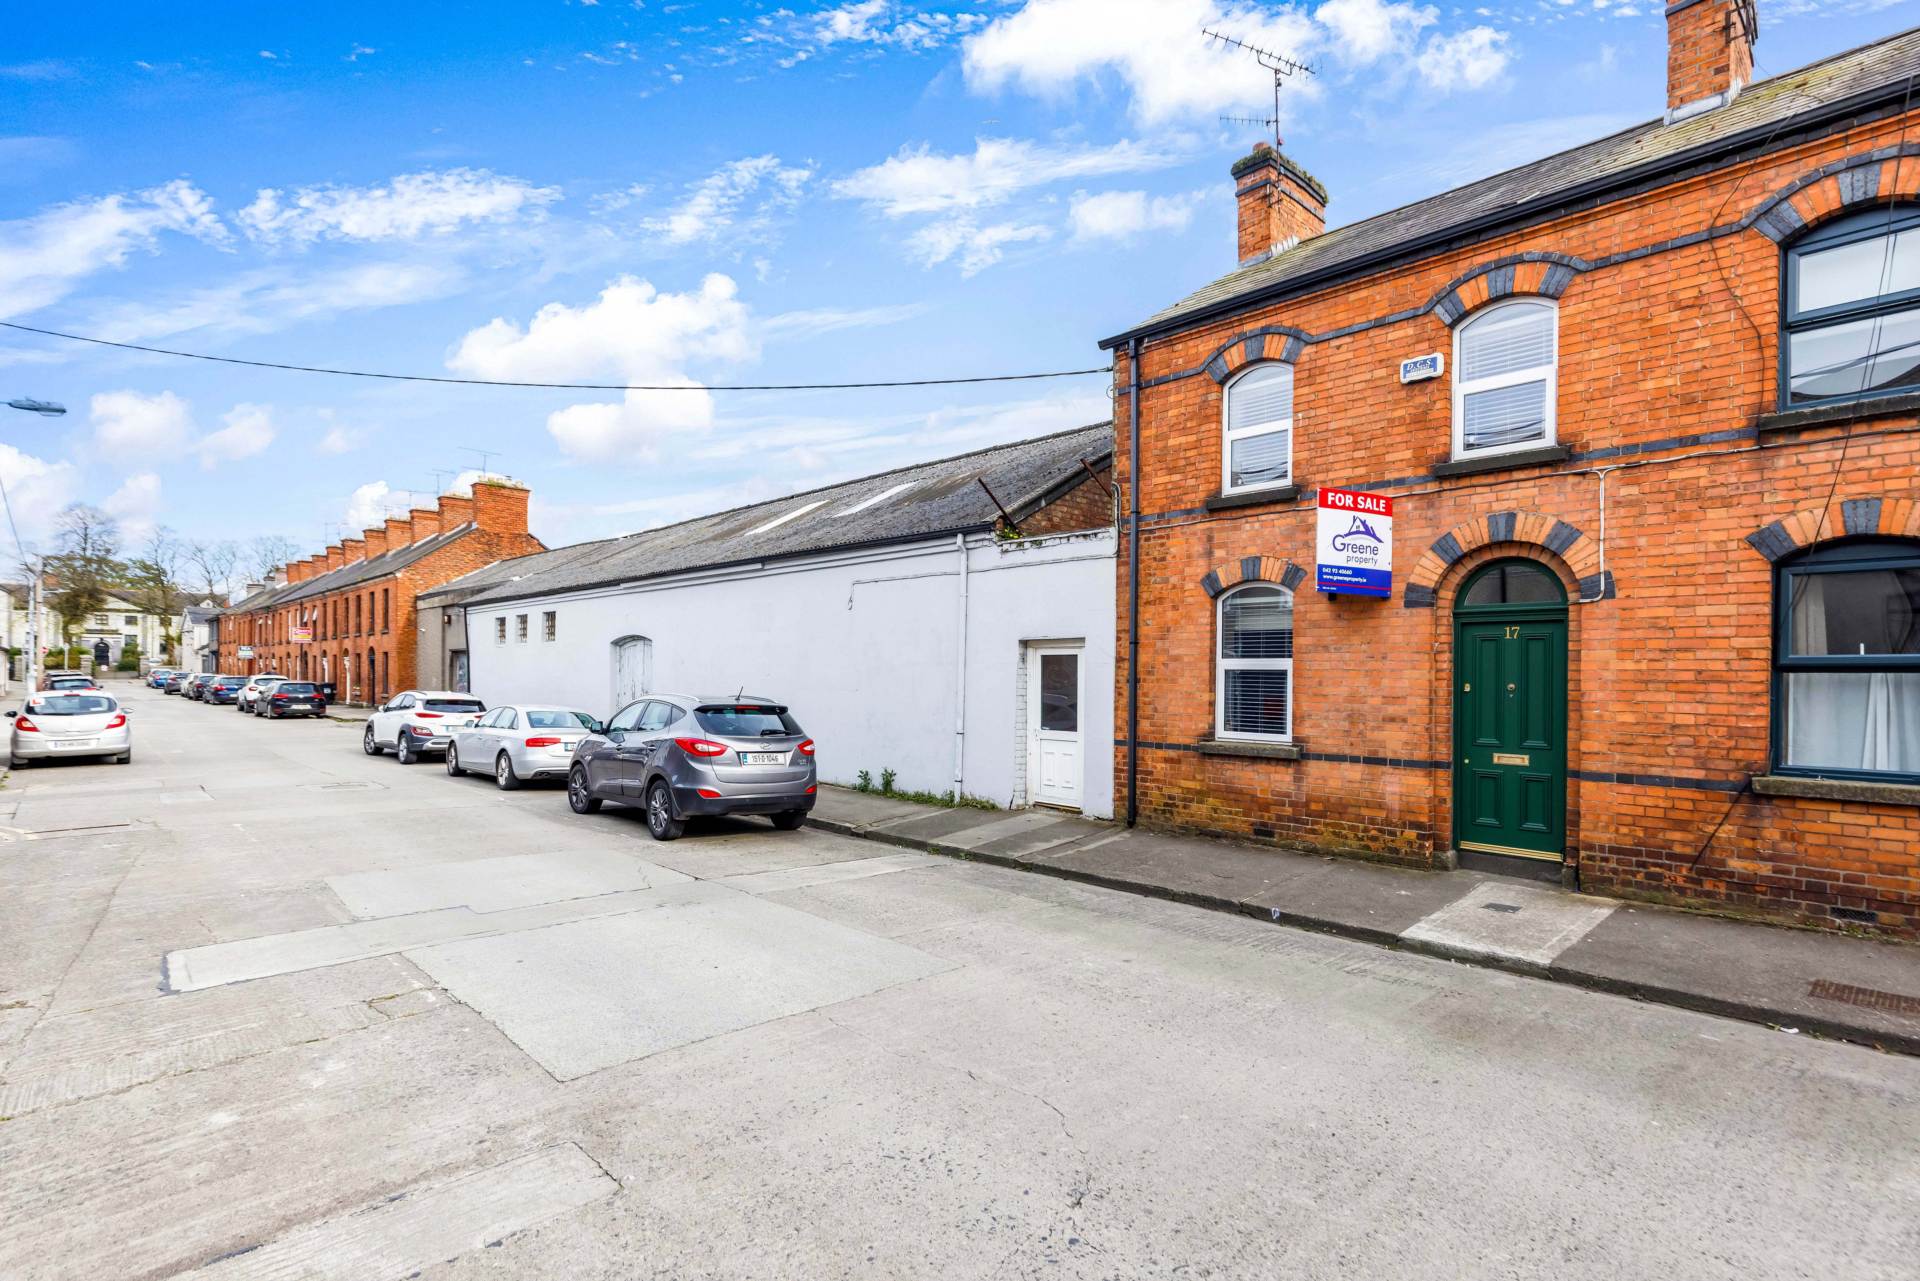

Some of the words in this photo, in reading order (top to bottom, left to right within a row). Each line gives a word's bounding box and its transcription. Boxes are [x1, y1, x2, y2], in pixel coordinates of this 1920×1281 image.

[1327, 492, 1354, 508] FOR
[1357, 496, 1386, 512] SALE
[1332, 534, 1379, 555] Greene
[1346, 555, 1378, 566] property
[1503, 626, 1520, 639] 17
